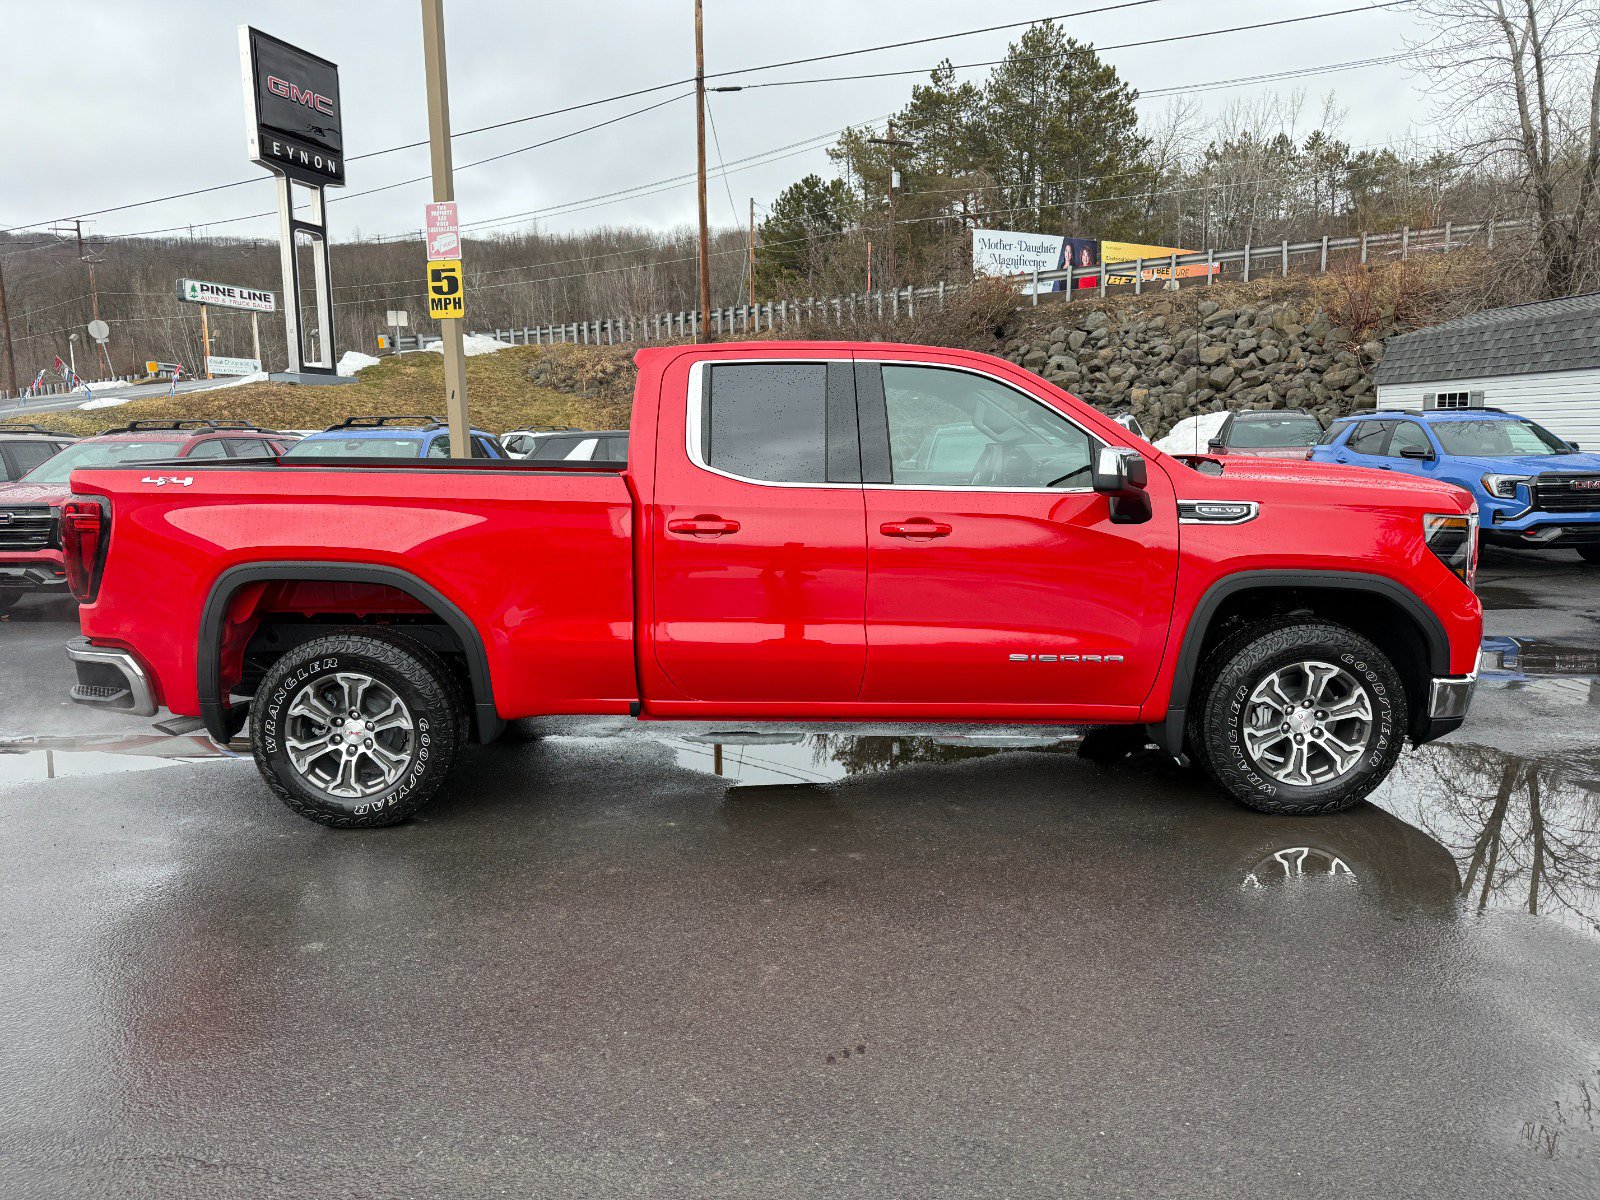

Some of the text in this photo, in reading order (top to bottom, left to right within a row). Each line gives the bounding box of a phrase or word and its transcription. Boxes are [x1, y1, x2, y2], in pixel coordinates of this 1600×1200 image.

[268, 75, 334, 117] GMC
[272, 141, 336, 174] EYNON
[989, 253, 1047, 270] Magnificence
[200, 284, 272, 303] PINE LINE
[431, 267, 458, 296] 5
[201, 295, 219, 303] AUTO
[229, 299, 251, 307] TRUCK
[431, 297, 462, 311] MPH
[1575, 480, 1600, 489] GM
[1009, 653, 1124, 663] SIERRA
[264, 657, 338, 754] WRANGLER
[1340, 653, 1392, 767] GOODYEAR
[1228, 685, 1277, 797] WRANGLER
[354, 717, 431, 815] GOODYEAR
